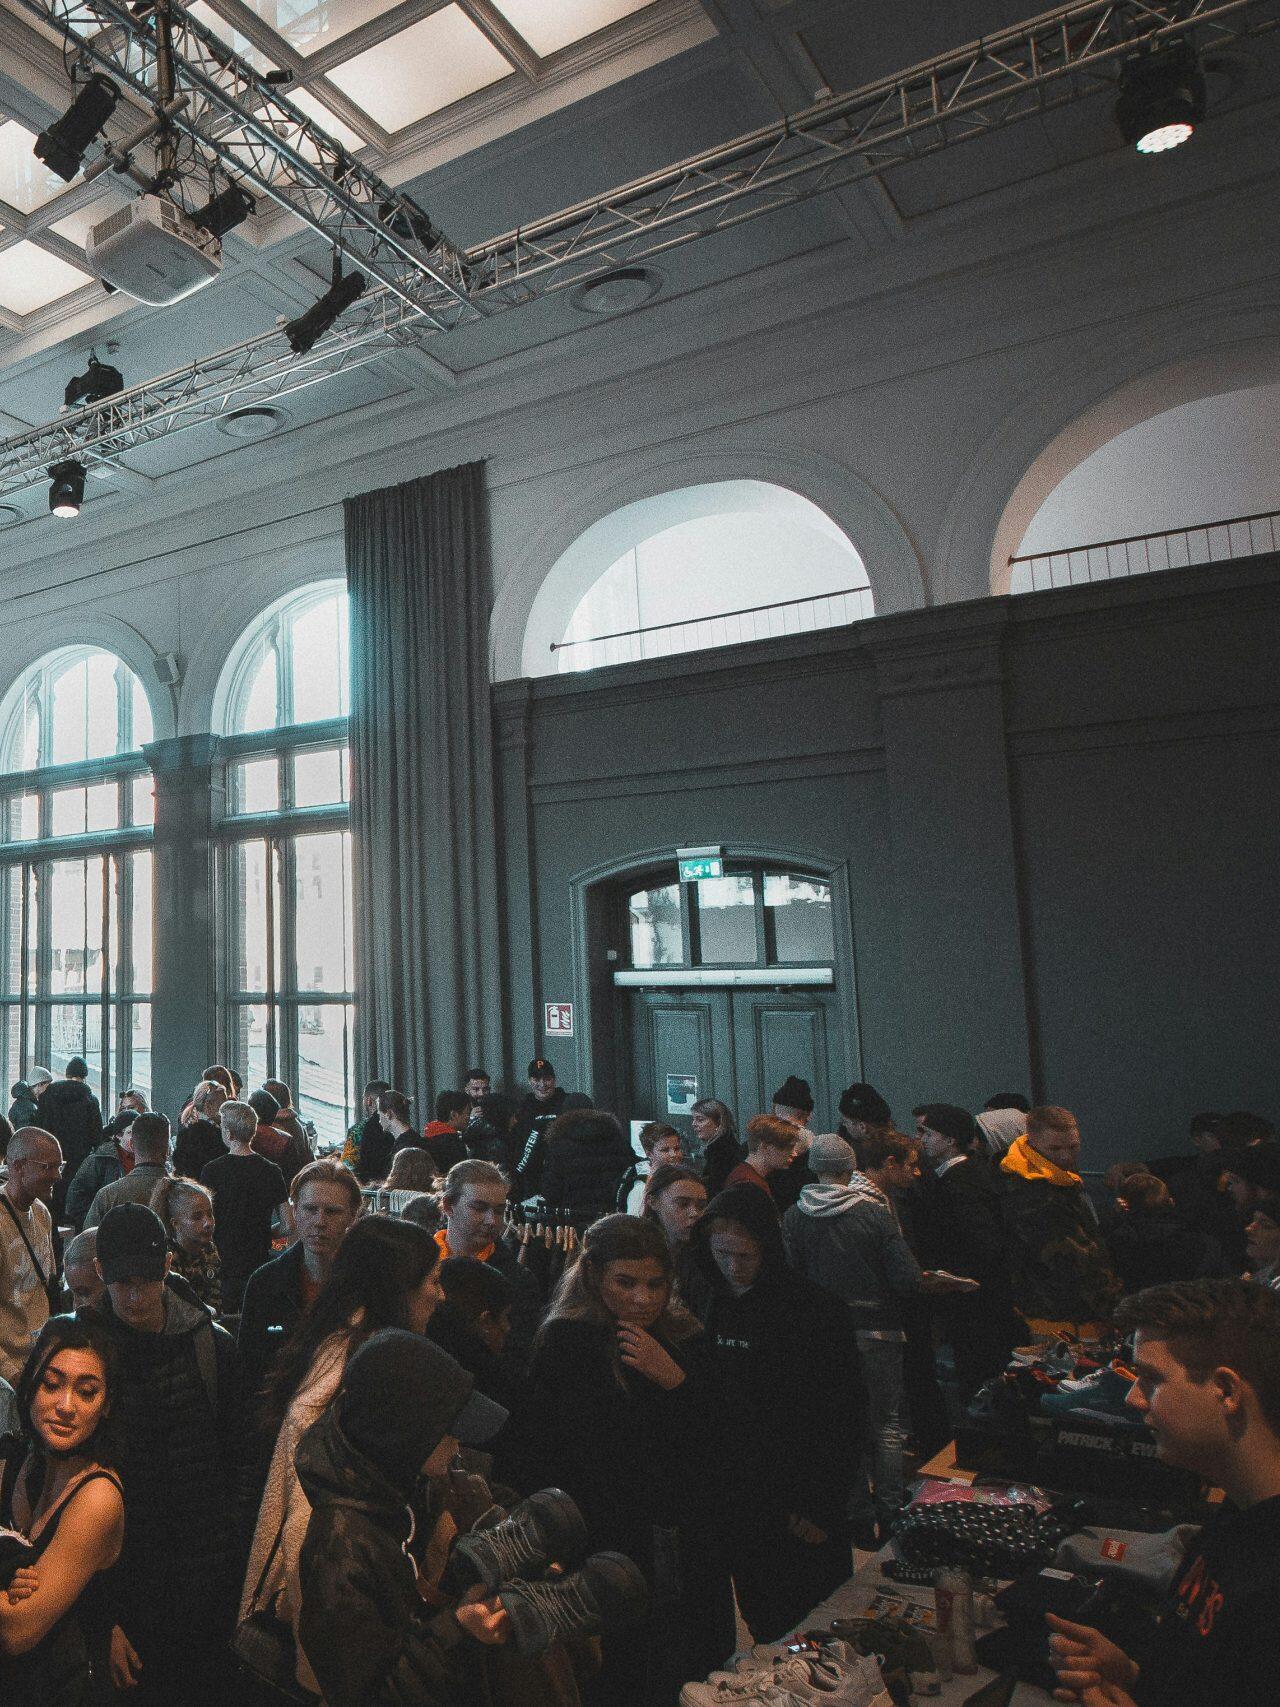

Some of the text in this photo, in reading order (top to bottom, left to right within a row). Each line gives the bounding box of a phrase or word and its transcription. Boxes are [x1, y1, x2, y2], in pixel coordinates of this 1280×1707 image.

[537, 1060, 544, 1069] P
[516, 1129, 539, 1173] HYPESTEIN
[1057, 1430, 1114, 1450] PATRICK
